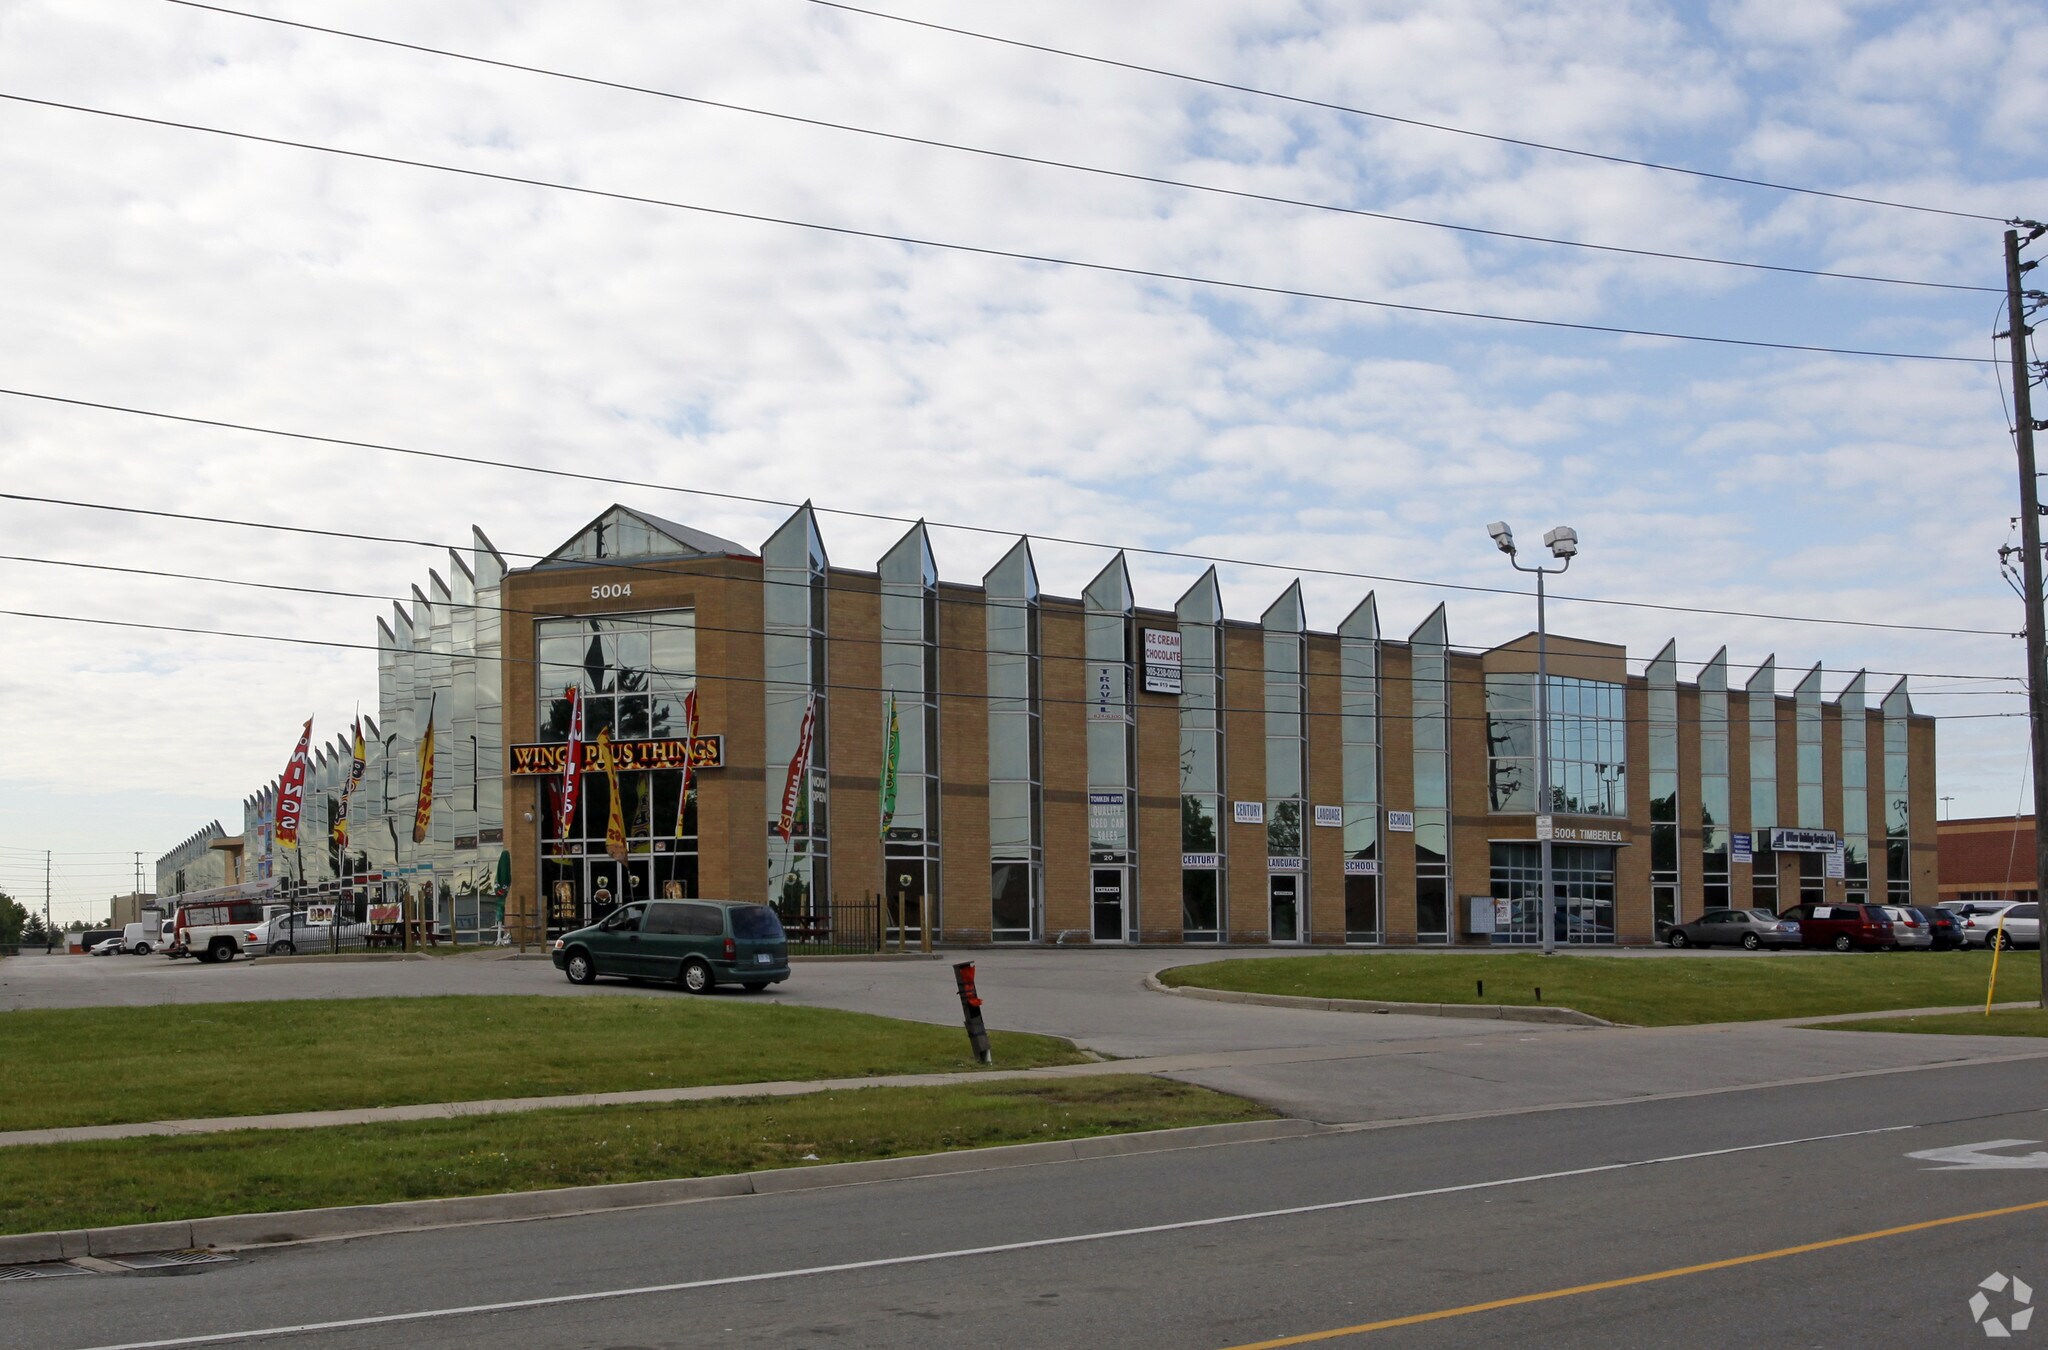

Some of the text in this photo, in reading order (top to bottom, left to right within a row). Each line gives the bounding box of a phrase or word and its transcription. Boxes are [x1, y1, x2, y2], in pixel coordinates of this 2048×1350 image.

[591, 584, 632, 599] 5004
[1146, 633, 1179, 646] ICE CREAM
[1146, 649, 1181, 661] CHOCOLATE
[1100, 668, 1111, 713] TRAVEL
[514, 747, 570, 767] WING
[637, 740, 717, 762] THINGS
[811, 776, 826, 788] NOW
[812, 790, 827, 803] OPEN
[1093, 806, 1121, 816] QUALITY
[1236, 804, 1260, 816] CENTURY
[1317, 807, 1340, 820] LANGUAGE
[1091, 818, 1125, 828] USED CAR
[1390, 812, 1411, 826] SCHOOL
[1098, 831, 1118, 841] SALES
[1555, 828, 1576, 839] 5004
[1580, 829, 1622, 841] TIMBERLEA
[1183, 856, 1216, 864] CENTURY
[1268, 859, 1300, 867] LANGUAGE
[1345, 861, 1375, 870] SCHOOL
[309, 910, 333, 921] BBQ
